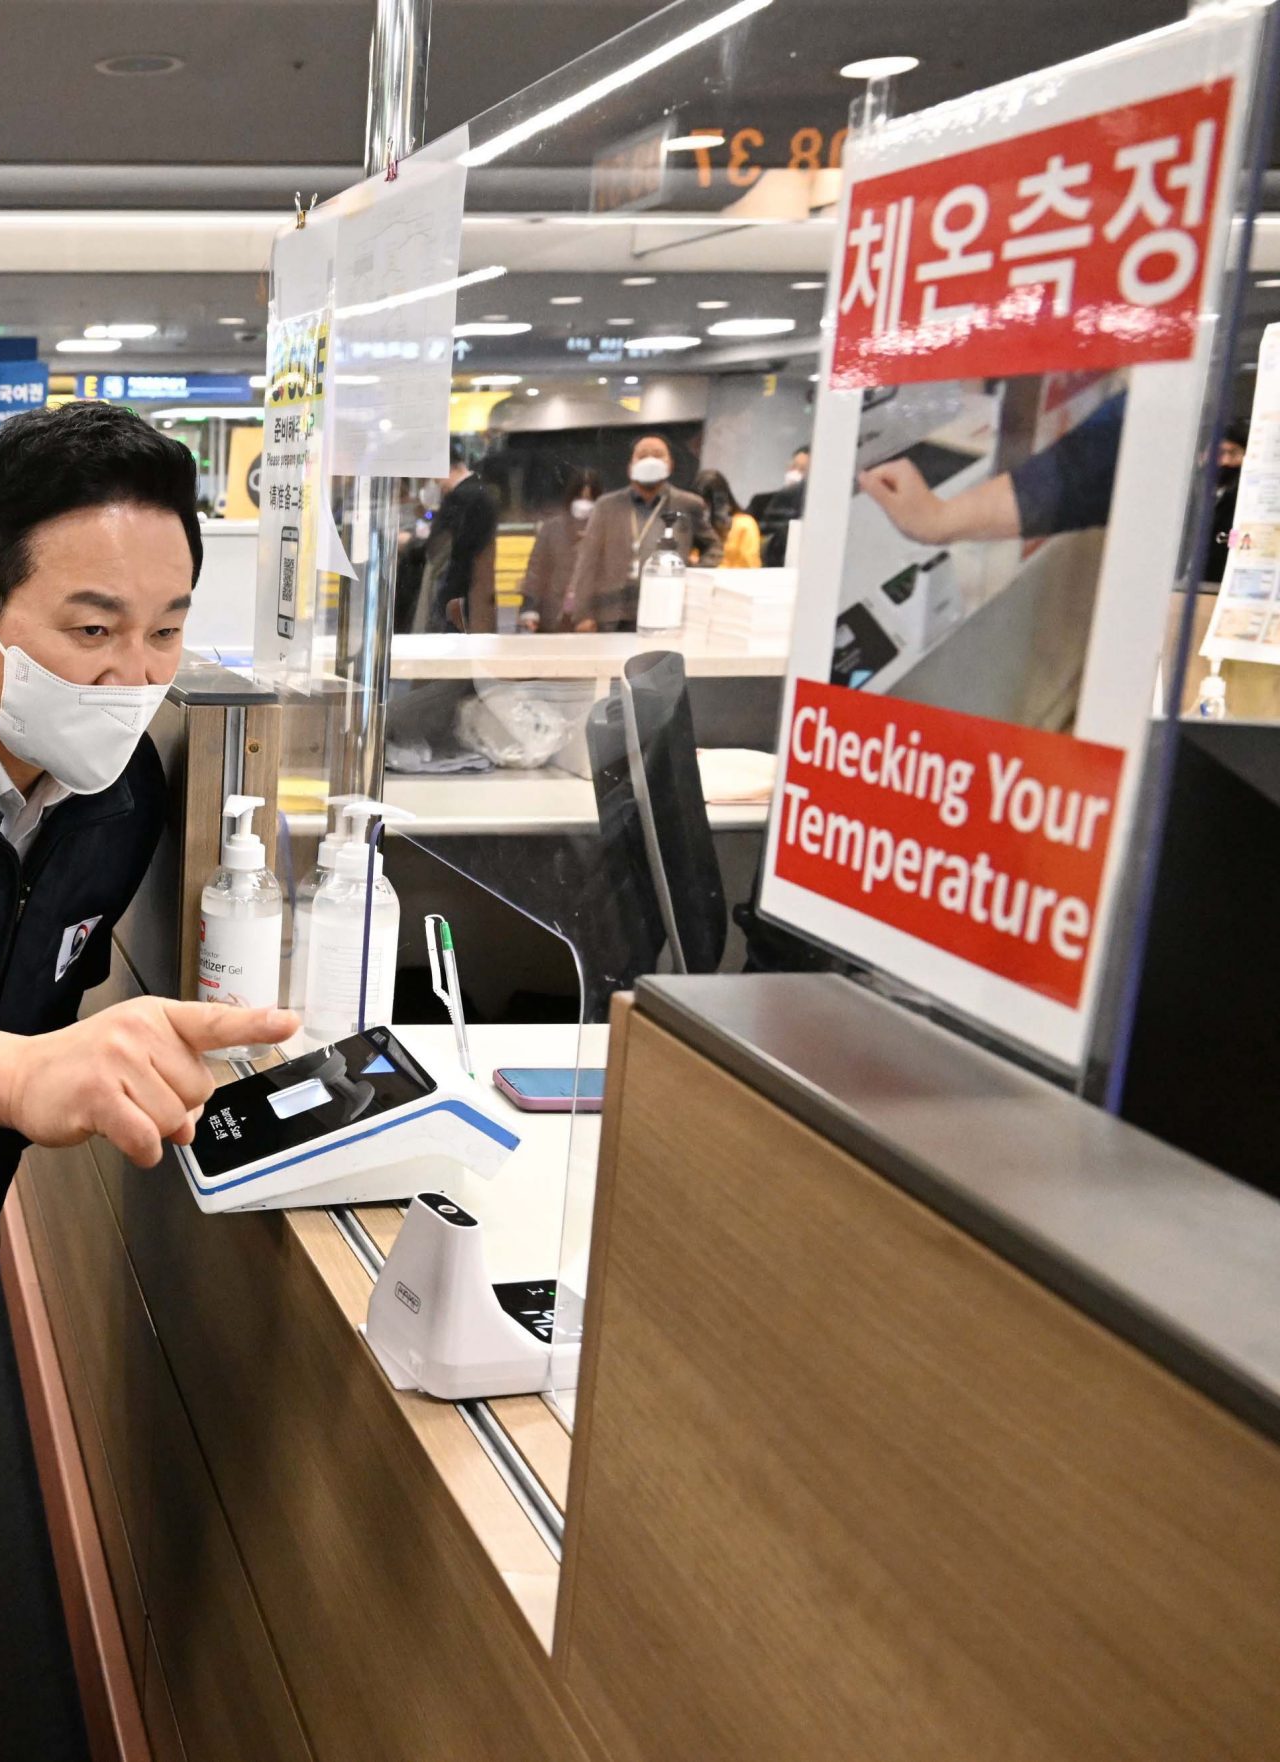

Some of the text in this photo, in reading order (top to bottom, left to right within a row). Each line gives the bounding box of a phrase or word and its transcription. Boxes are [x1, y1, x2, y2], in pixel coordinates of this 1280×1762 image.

[840, 119, 1217, 338] 체온측정
[790, 705, 1109, 851] Checking Your
[783, 783, 1091, 961] Temperature
[199, 956, 227, 973] nitizer
[228, 965, 243, 976] Gel
[220, 1107, 243, 1140] Barcode Scan
